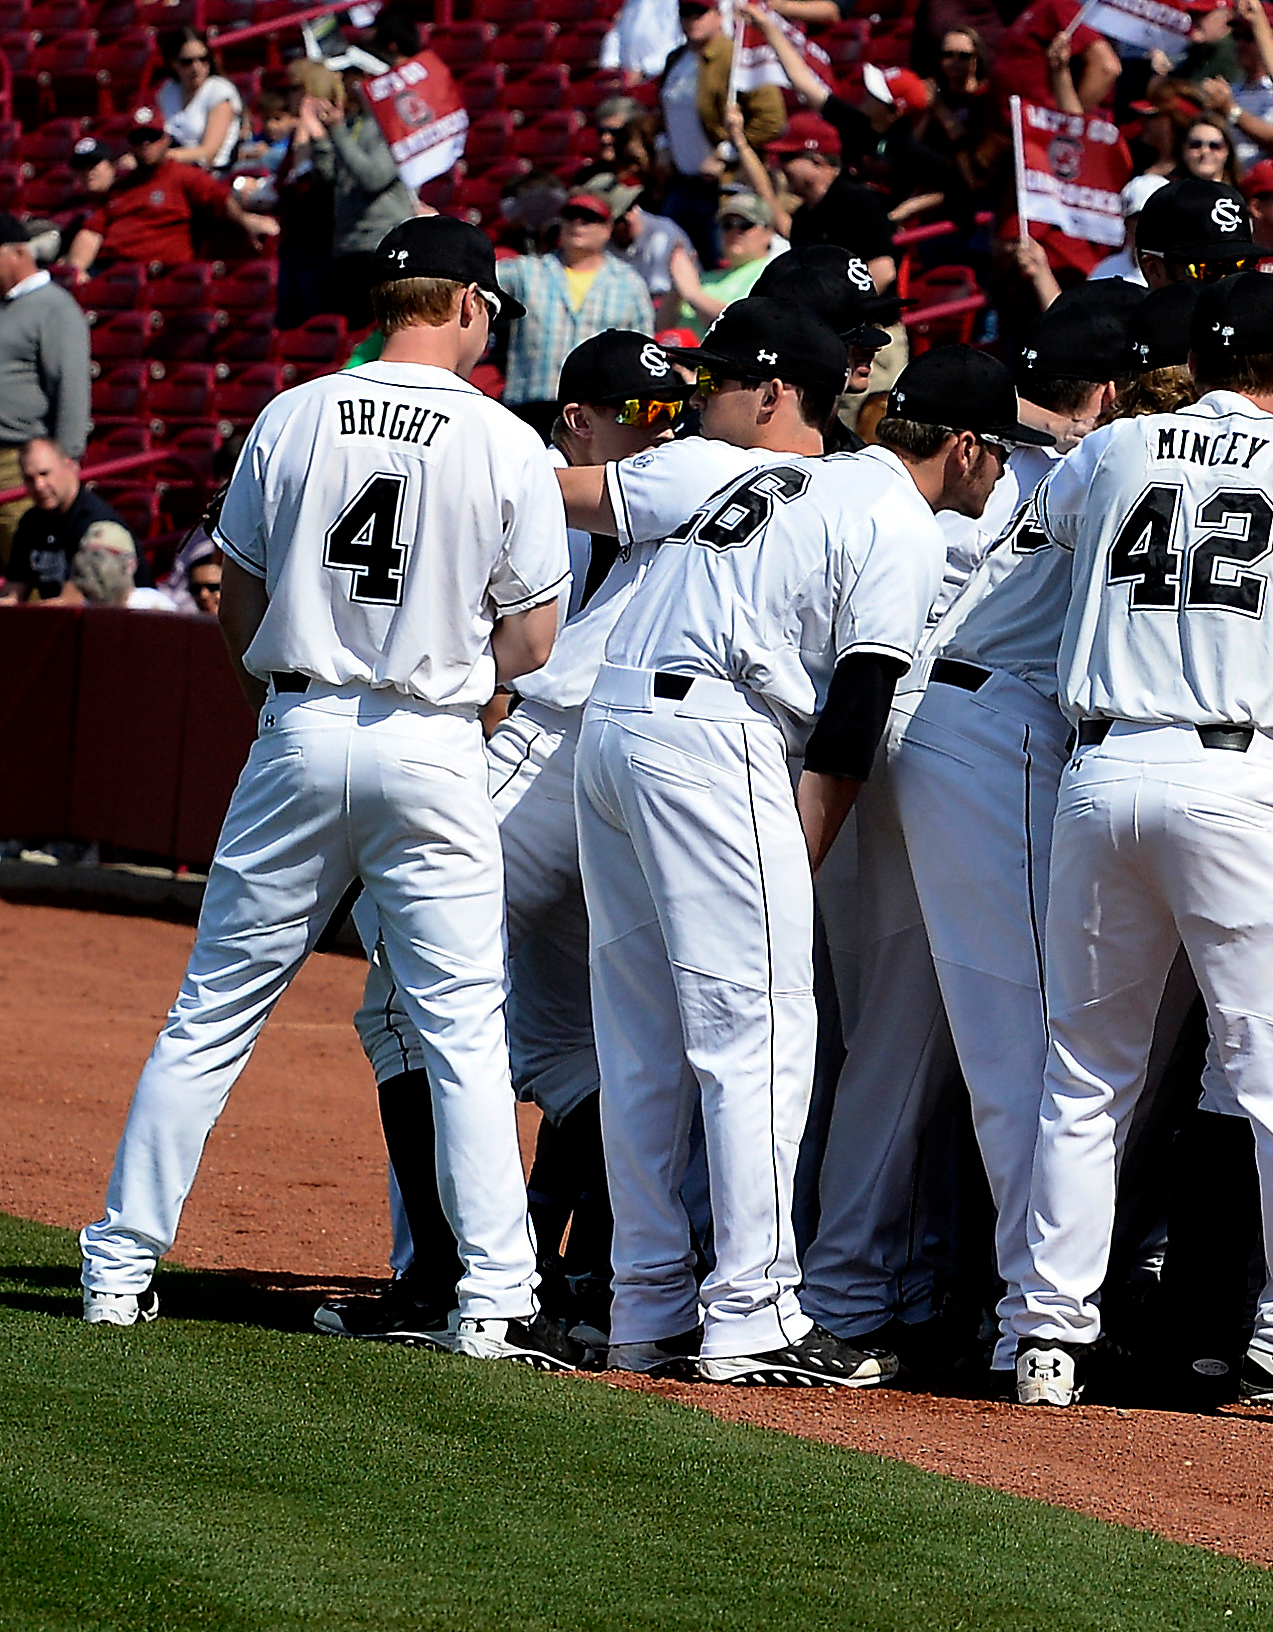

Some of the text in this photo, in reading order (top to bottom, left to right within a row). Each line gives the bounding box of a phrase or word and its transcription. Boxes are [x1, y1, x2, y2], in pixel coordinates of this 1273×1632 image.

[337, 399, 450, 449] BRIGHT
[1156, 427, 1270, 469] MINCEY
[322, 471, 409, 605] 4
